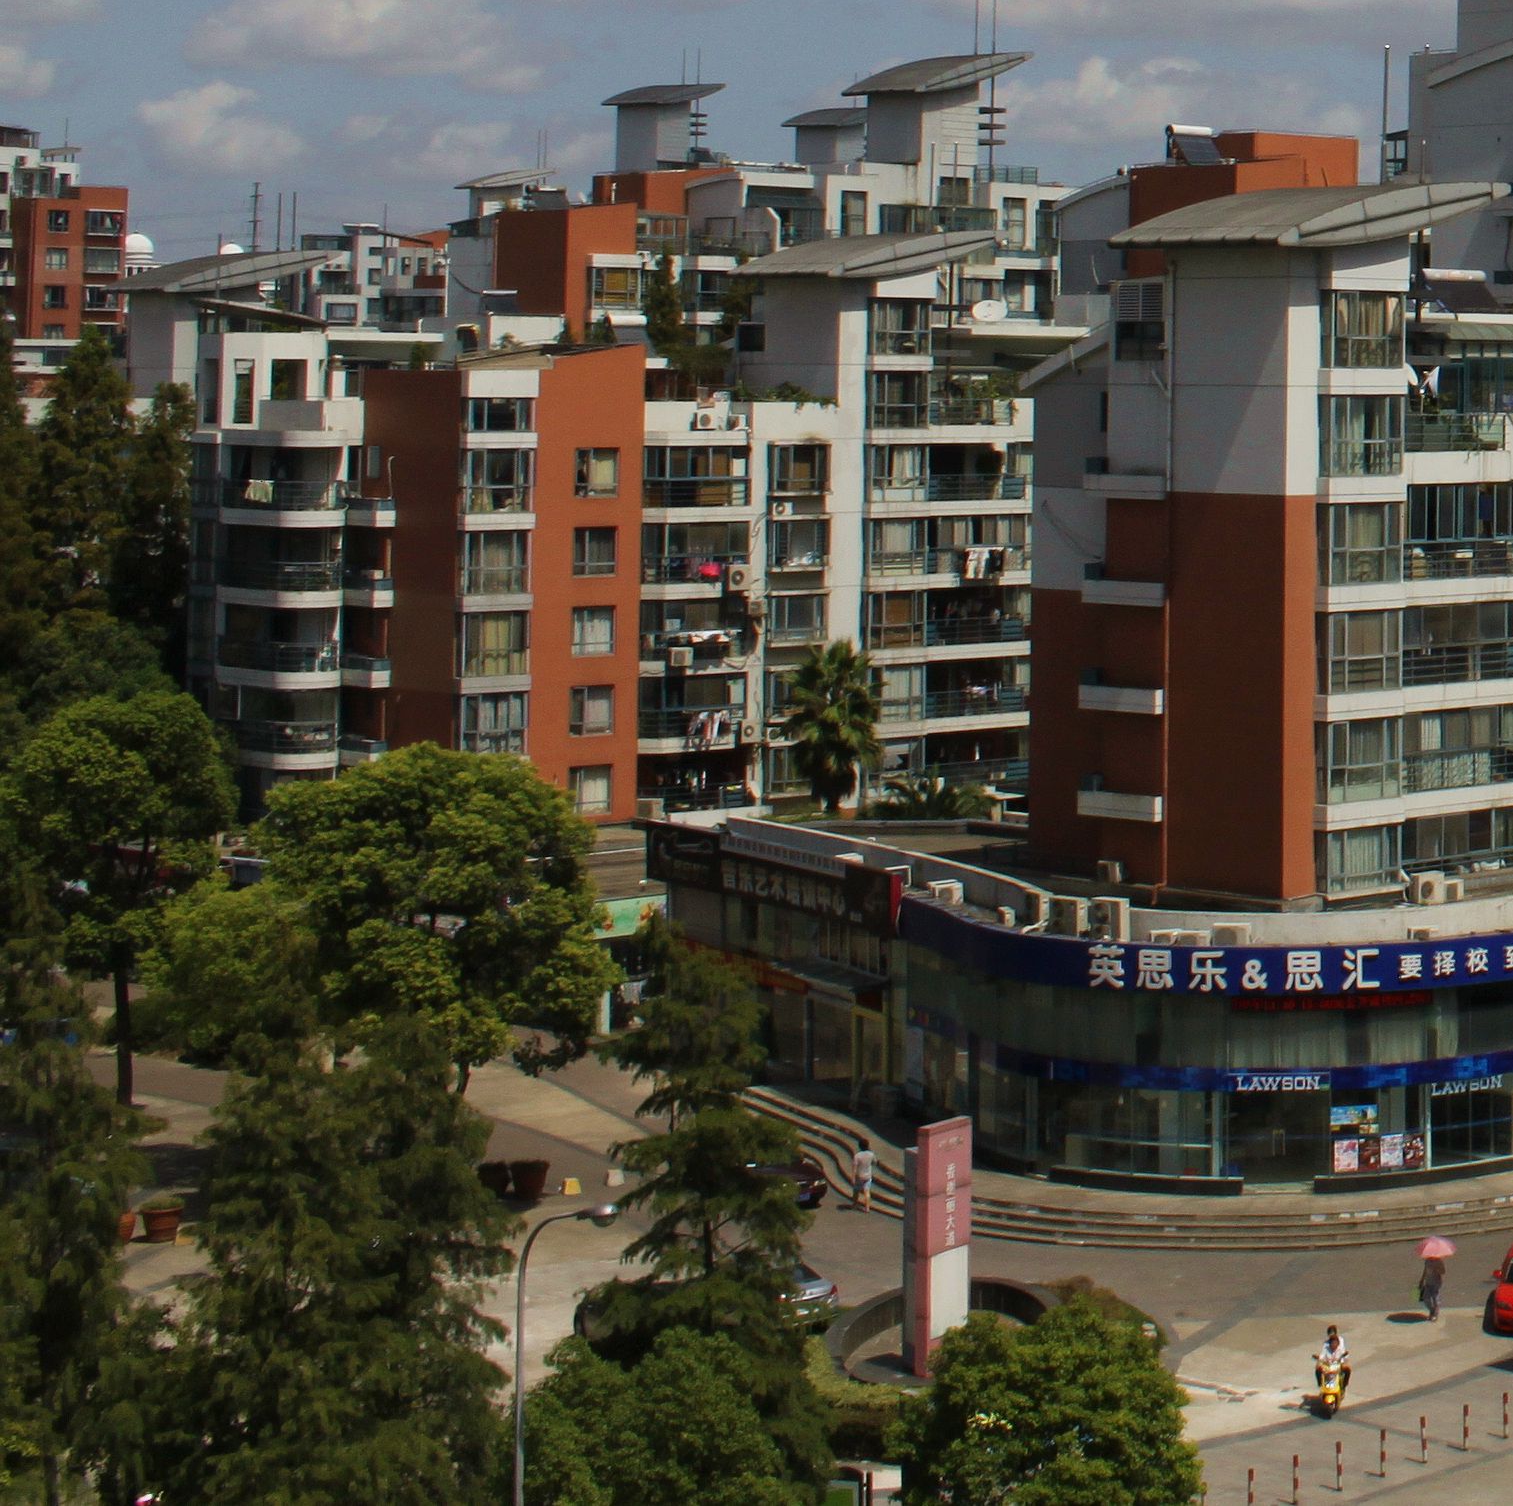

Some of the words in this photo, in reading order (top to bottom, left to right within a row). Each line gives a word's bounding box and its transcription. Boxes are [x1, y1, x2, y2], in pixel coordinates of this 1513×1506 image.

[1087, 943, 1381, 992] 英思乐&思汇
[1398, 947, 1490, 981] 要择校
[1236, 1074, 1321, 1092] LAWSON
[1430, 1074, 1504, 1097] LAWSON
